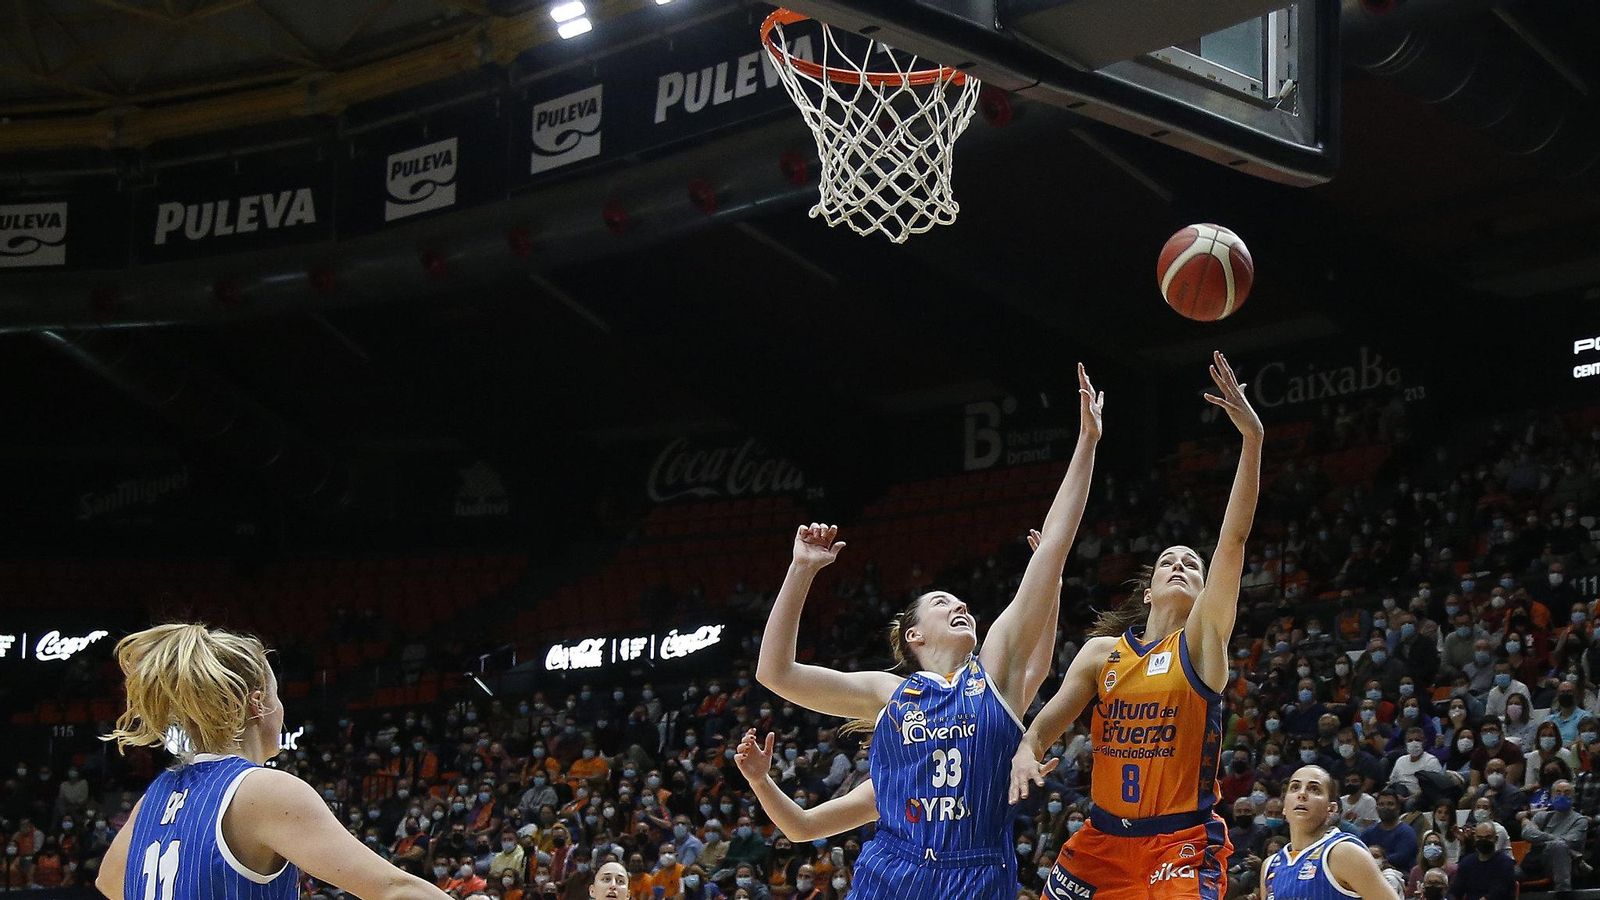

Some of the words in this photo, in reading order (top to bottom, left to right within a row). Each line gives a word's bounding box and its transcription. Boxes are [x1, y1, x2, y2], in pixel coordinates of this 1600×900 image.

[536, 97, 598, 132] PULEVA
[390, 149, 453, 182] PULEVA
[0, 211, 62, 231] ULEVA
[154, 187, 317, 245] PULEVA
[1006, 445, 1052, 466] brand
[1096, 698, 1160, 720] Cultura
[1160, 705, 1179, 719] del
[931, 747, 963, 789] 33
[1121, 763, 1140, 804] 8
[143, 839, 182, 900] 11
[1050, 864, 1092, 900] PULEVA
